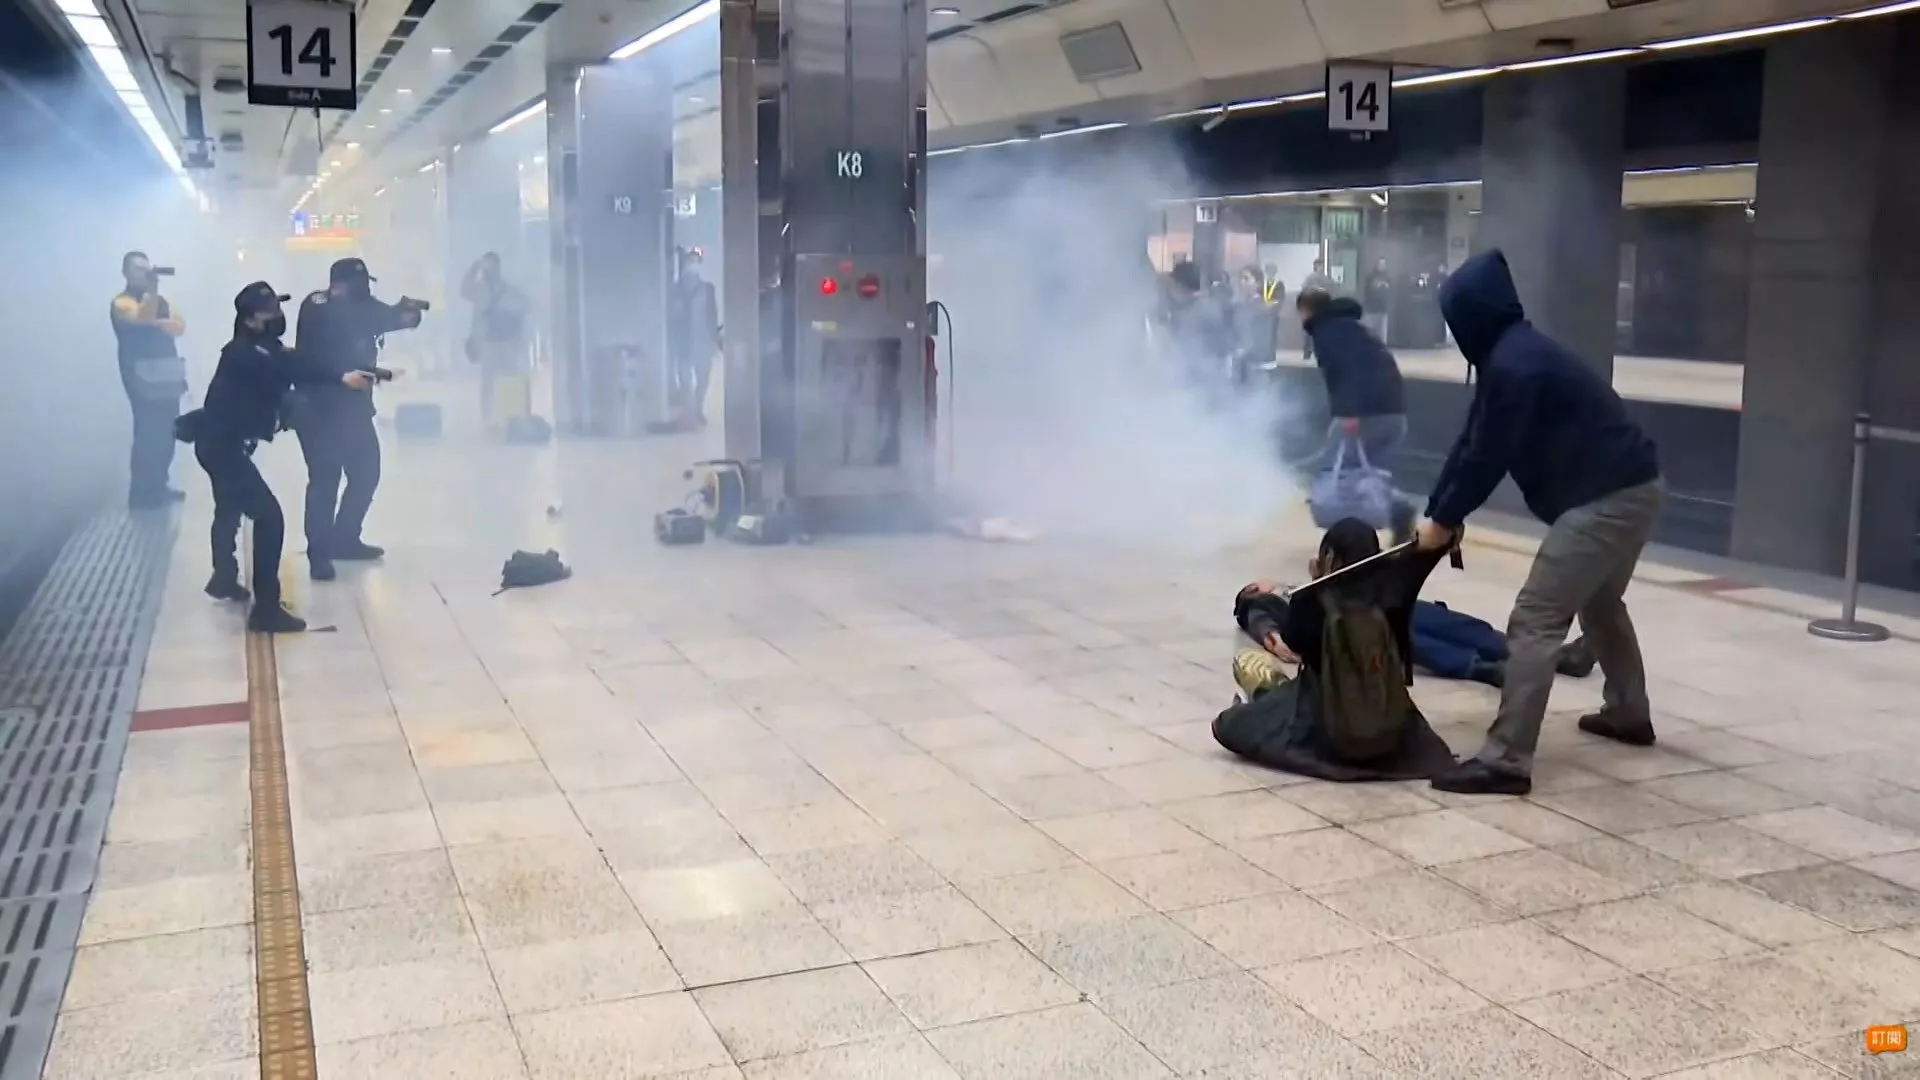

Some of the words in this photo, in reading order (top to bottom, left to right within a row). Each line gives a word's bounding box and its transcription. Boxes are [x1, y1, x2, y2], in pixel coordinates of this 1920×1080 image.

[268, 24, 336, 77] 14
[1338, 80, 1379, 121] 14
[838, 151, 863, 177] K8
[614, 196, 632, 213] K9
